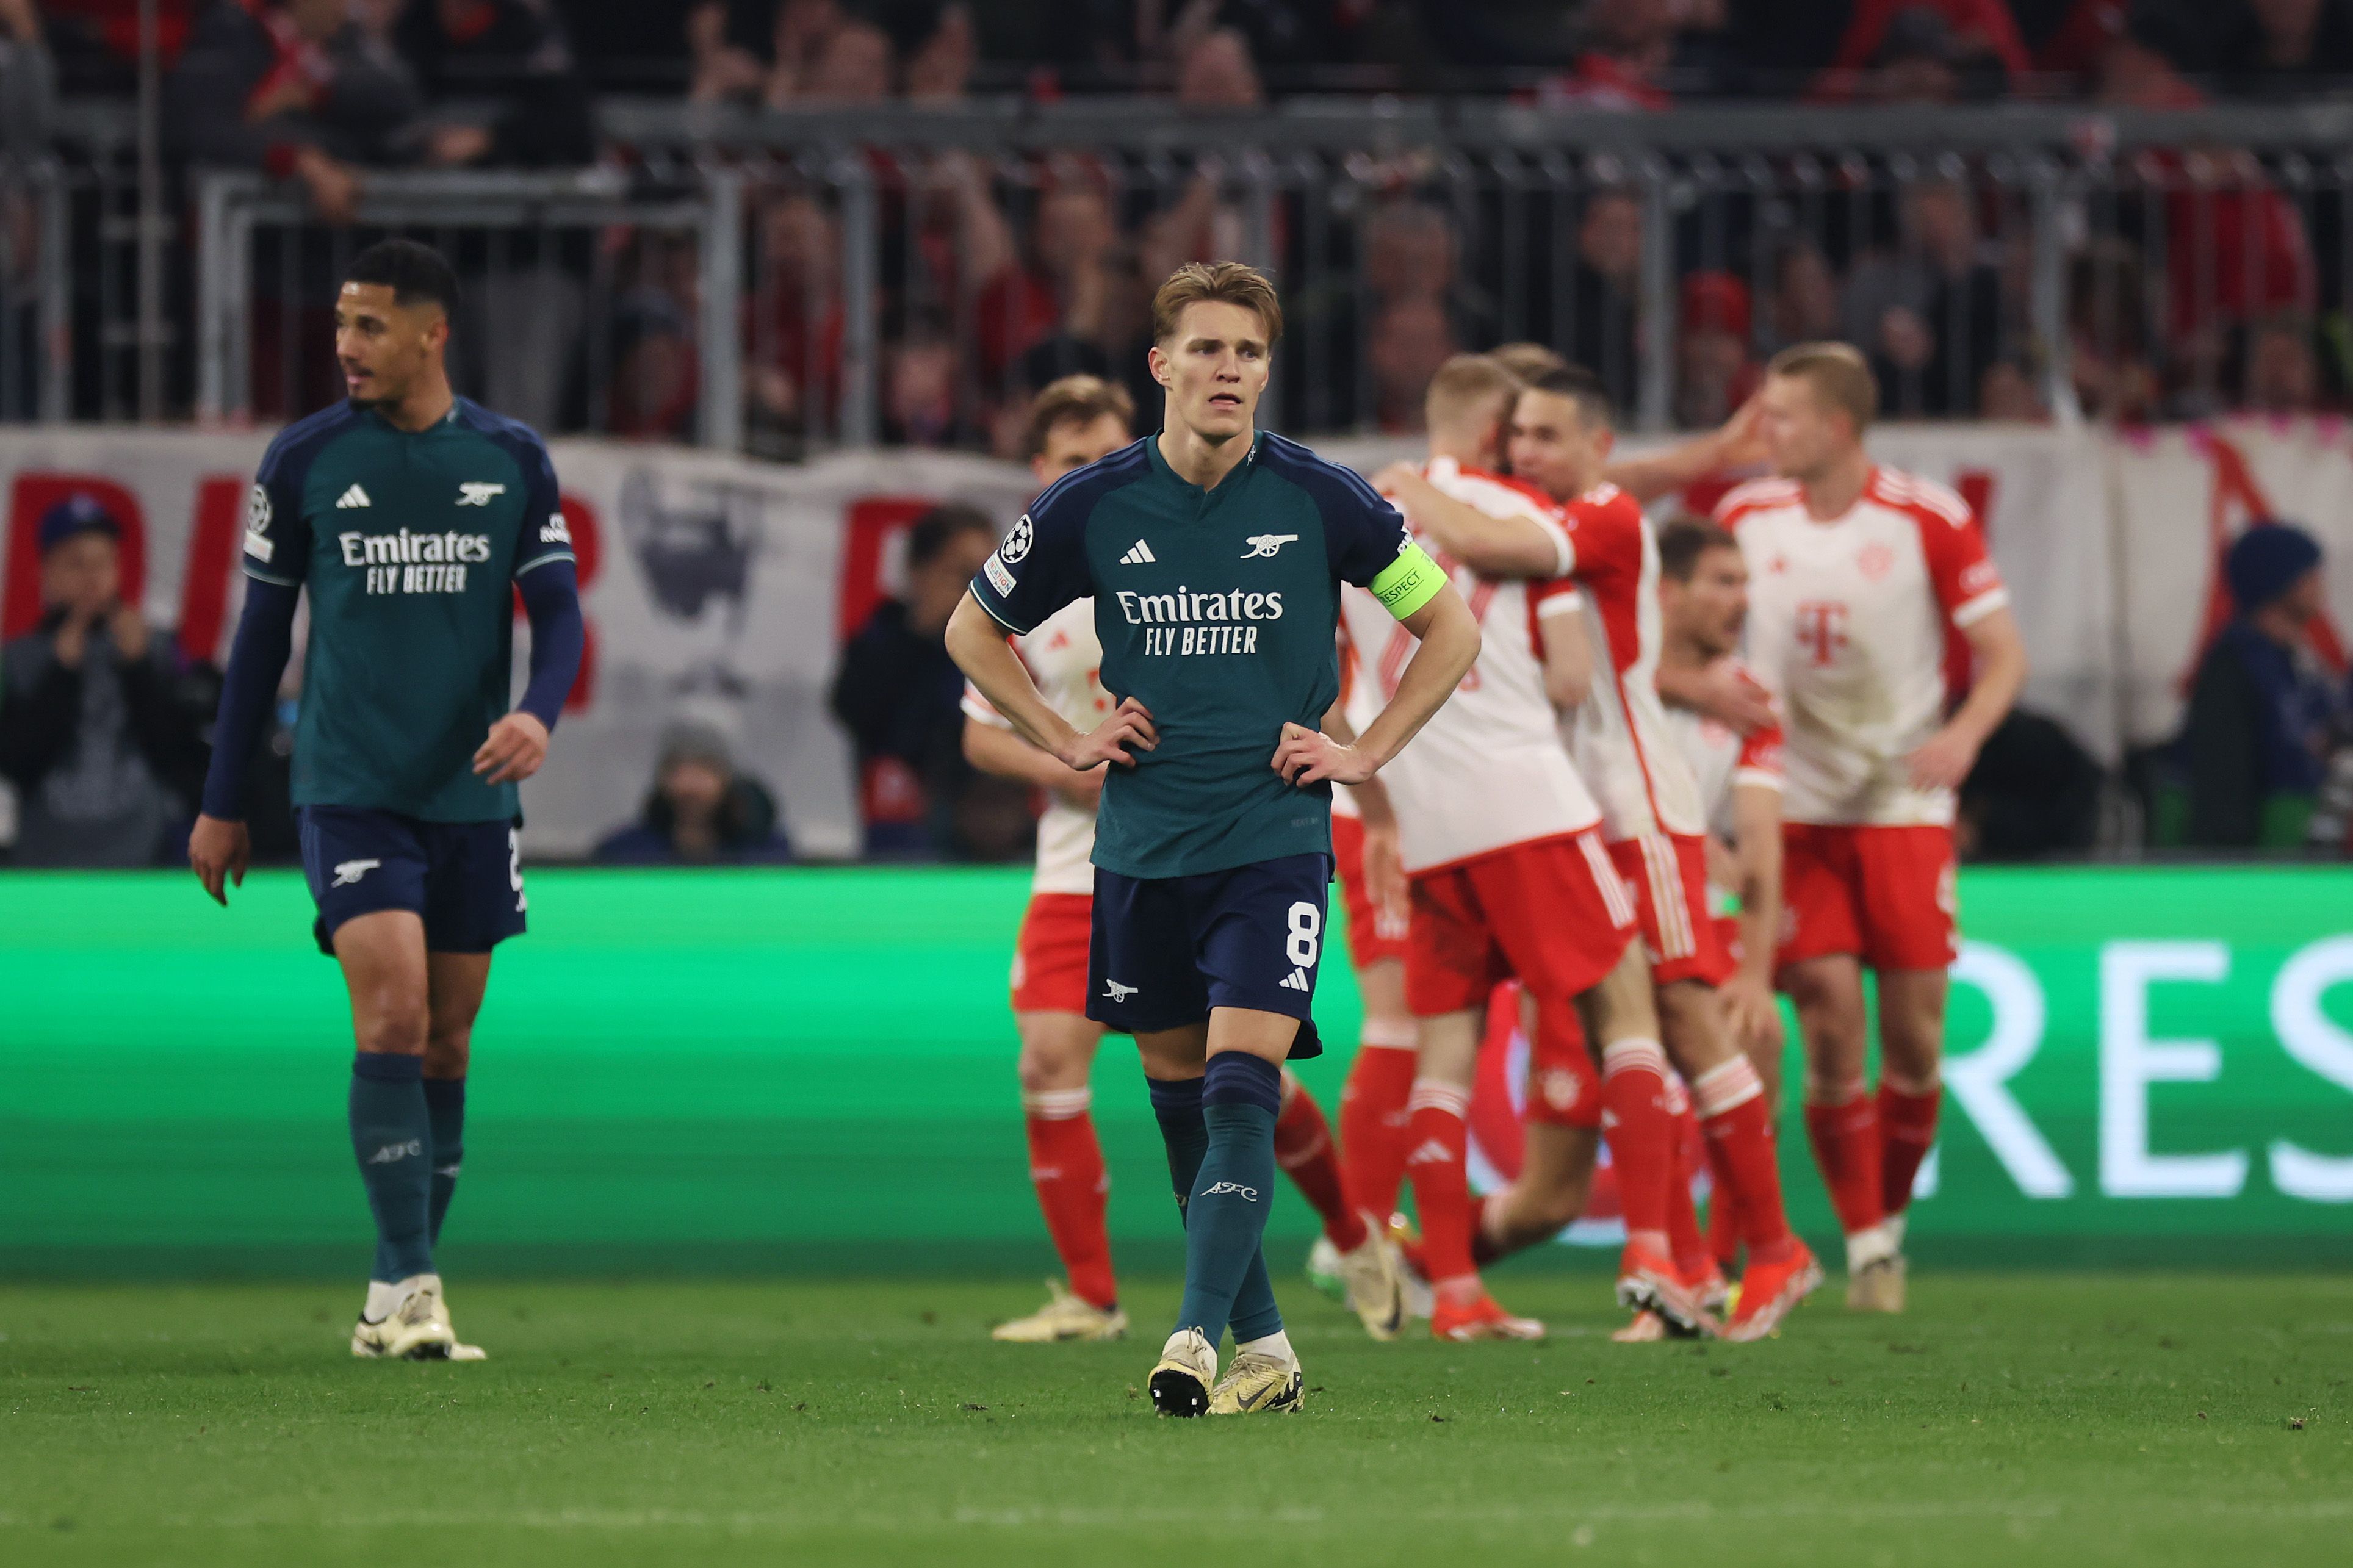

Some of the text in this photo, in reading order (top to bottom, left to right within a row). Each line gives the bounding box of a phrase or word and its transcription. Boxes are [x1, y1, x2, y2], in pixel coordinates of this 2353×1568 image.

[339, 527, 490, 566] Emirates
[367, 564, 467, 595] FLY BETTER
[1116, 586, 1283, 624] Emirates
[1145, 626, 1257, 655] FLY BETTER
[1286, 901, 1321, 968] 8
